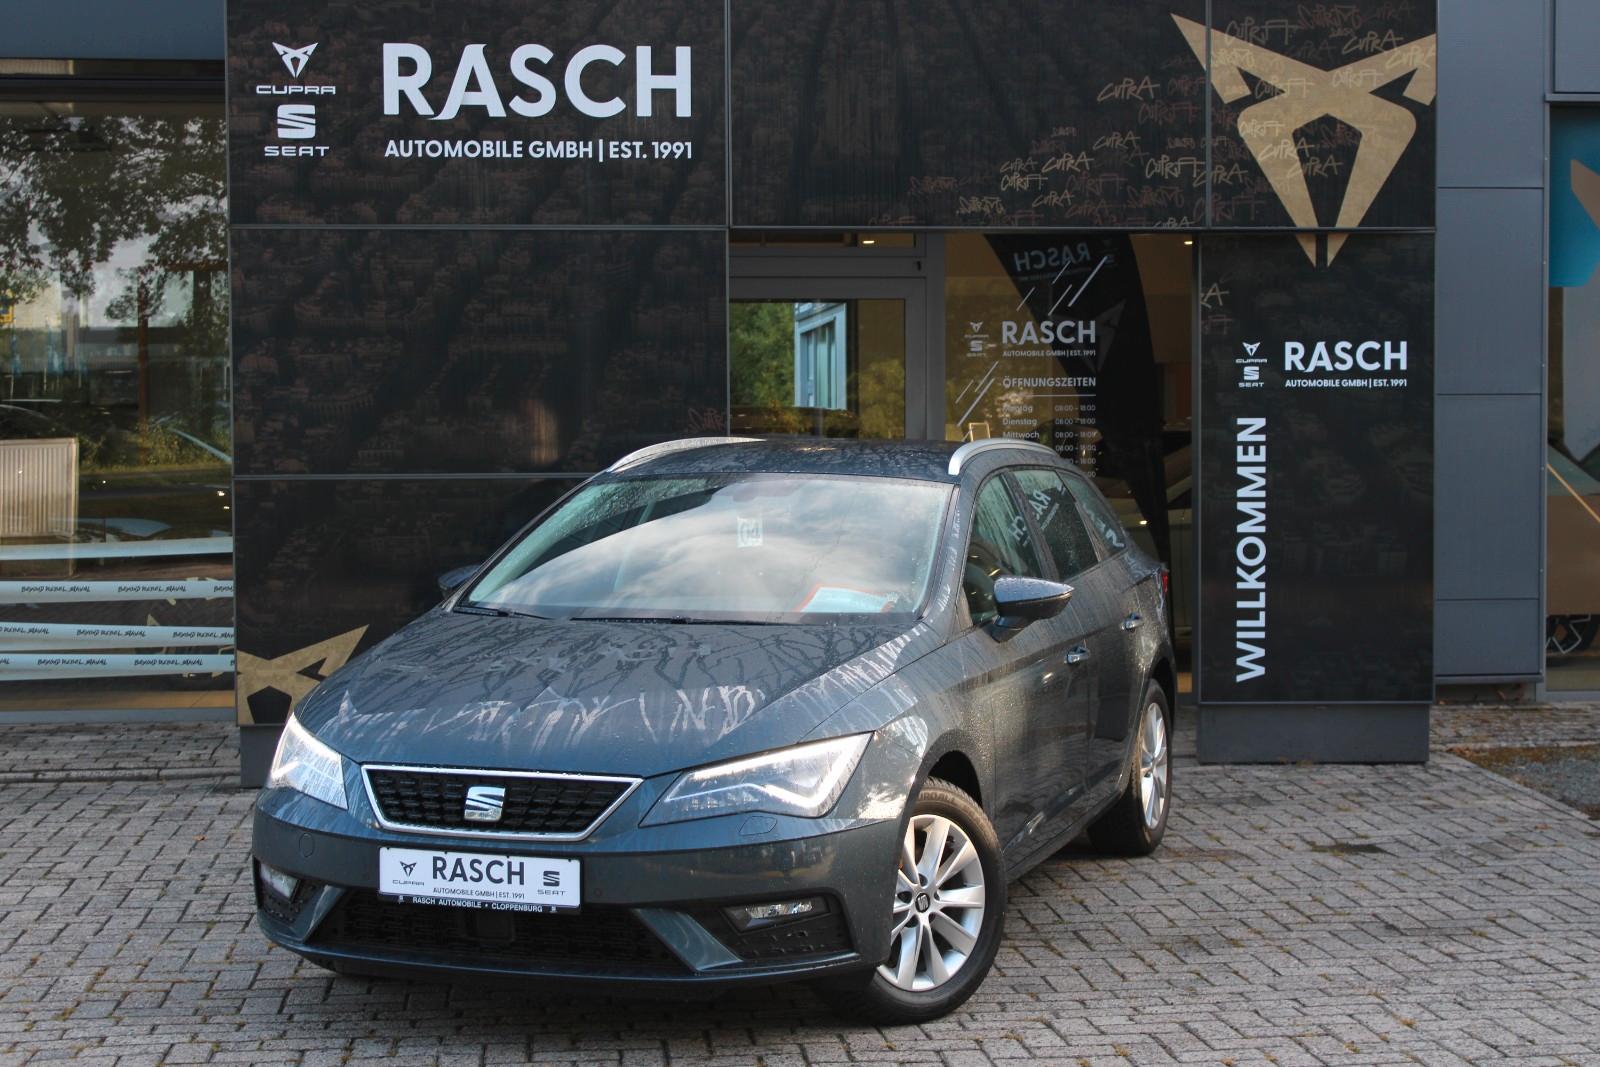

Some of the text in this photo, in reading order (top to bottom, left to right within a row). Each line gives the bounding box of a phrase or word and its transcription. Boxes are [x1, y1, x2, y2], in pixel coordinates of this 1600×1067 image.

[1342, 29, 1404, 54] CUPRA
[256, 85, 336, 95] CUPRA
[382, 42, 692, 121] RASCH
[1097, 76, 1160, 101] CUPRA
[384, 139, 692, 159] AUTOMOBILE GMBH EST. 1991
[1093, 130, 1140, 150] CUPRA
[264, 145, 330, 157] SEAT
[1041, 152, 1094, 173] CUPRA
[1002, 320, 1096, 345] RASCH
[1284, 341, 1408, 373] RASCH
[1003, 376, 1096, 388] ÖFFNUNGSZEITEN
[1285, 379, 1340, 388] AUTOMOBILE
[1341, 379, 1368, 388] GMBH
[1390, 379, 1408, 388] 1991
[1002, 418, 1038, 427] Dienstag
[1003, 431, 1040, 439] Mittwoch
[1236, 417, 1267, 683] WILLKOMMEN
[214, 585, 234, 593] BEYON
[432, 856, 525, 886] RASCH
[392, 879, 425, 887] CUPRA
[433, 887, 474, 897] AUTOMOBILE
[475, 890, 496, 898] GMBH
[512, 892, 525, 900] 1991
[412, 897, 543, 913] RASCH AUTOMOBILE CLOPPENBURG
